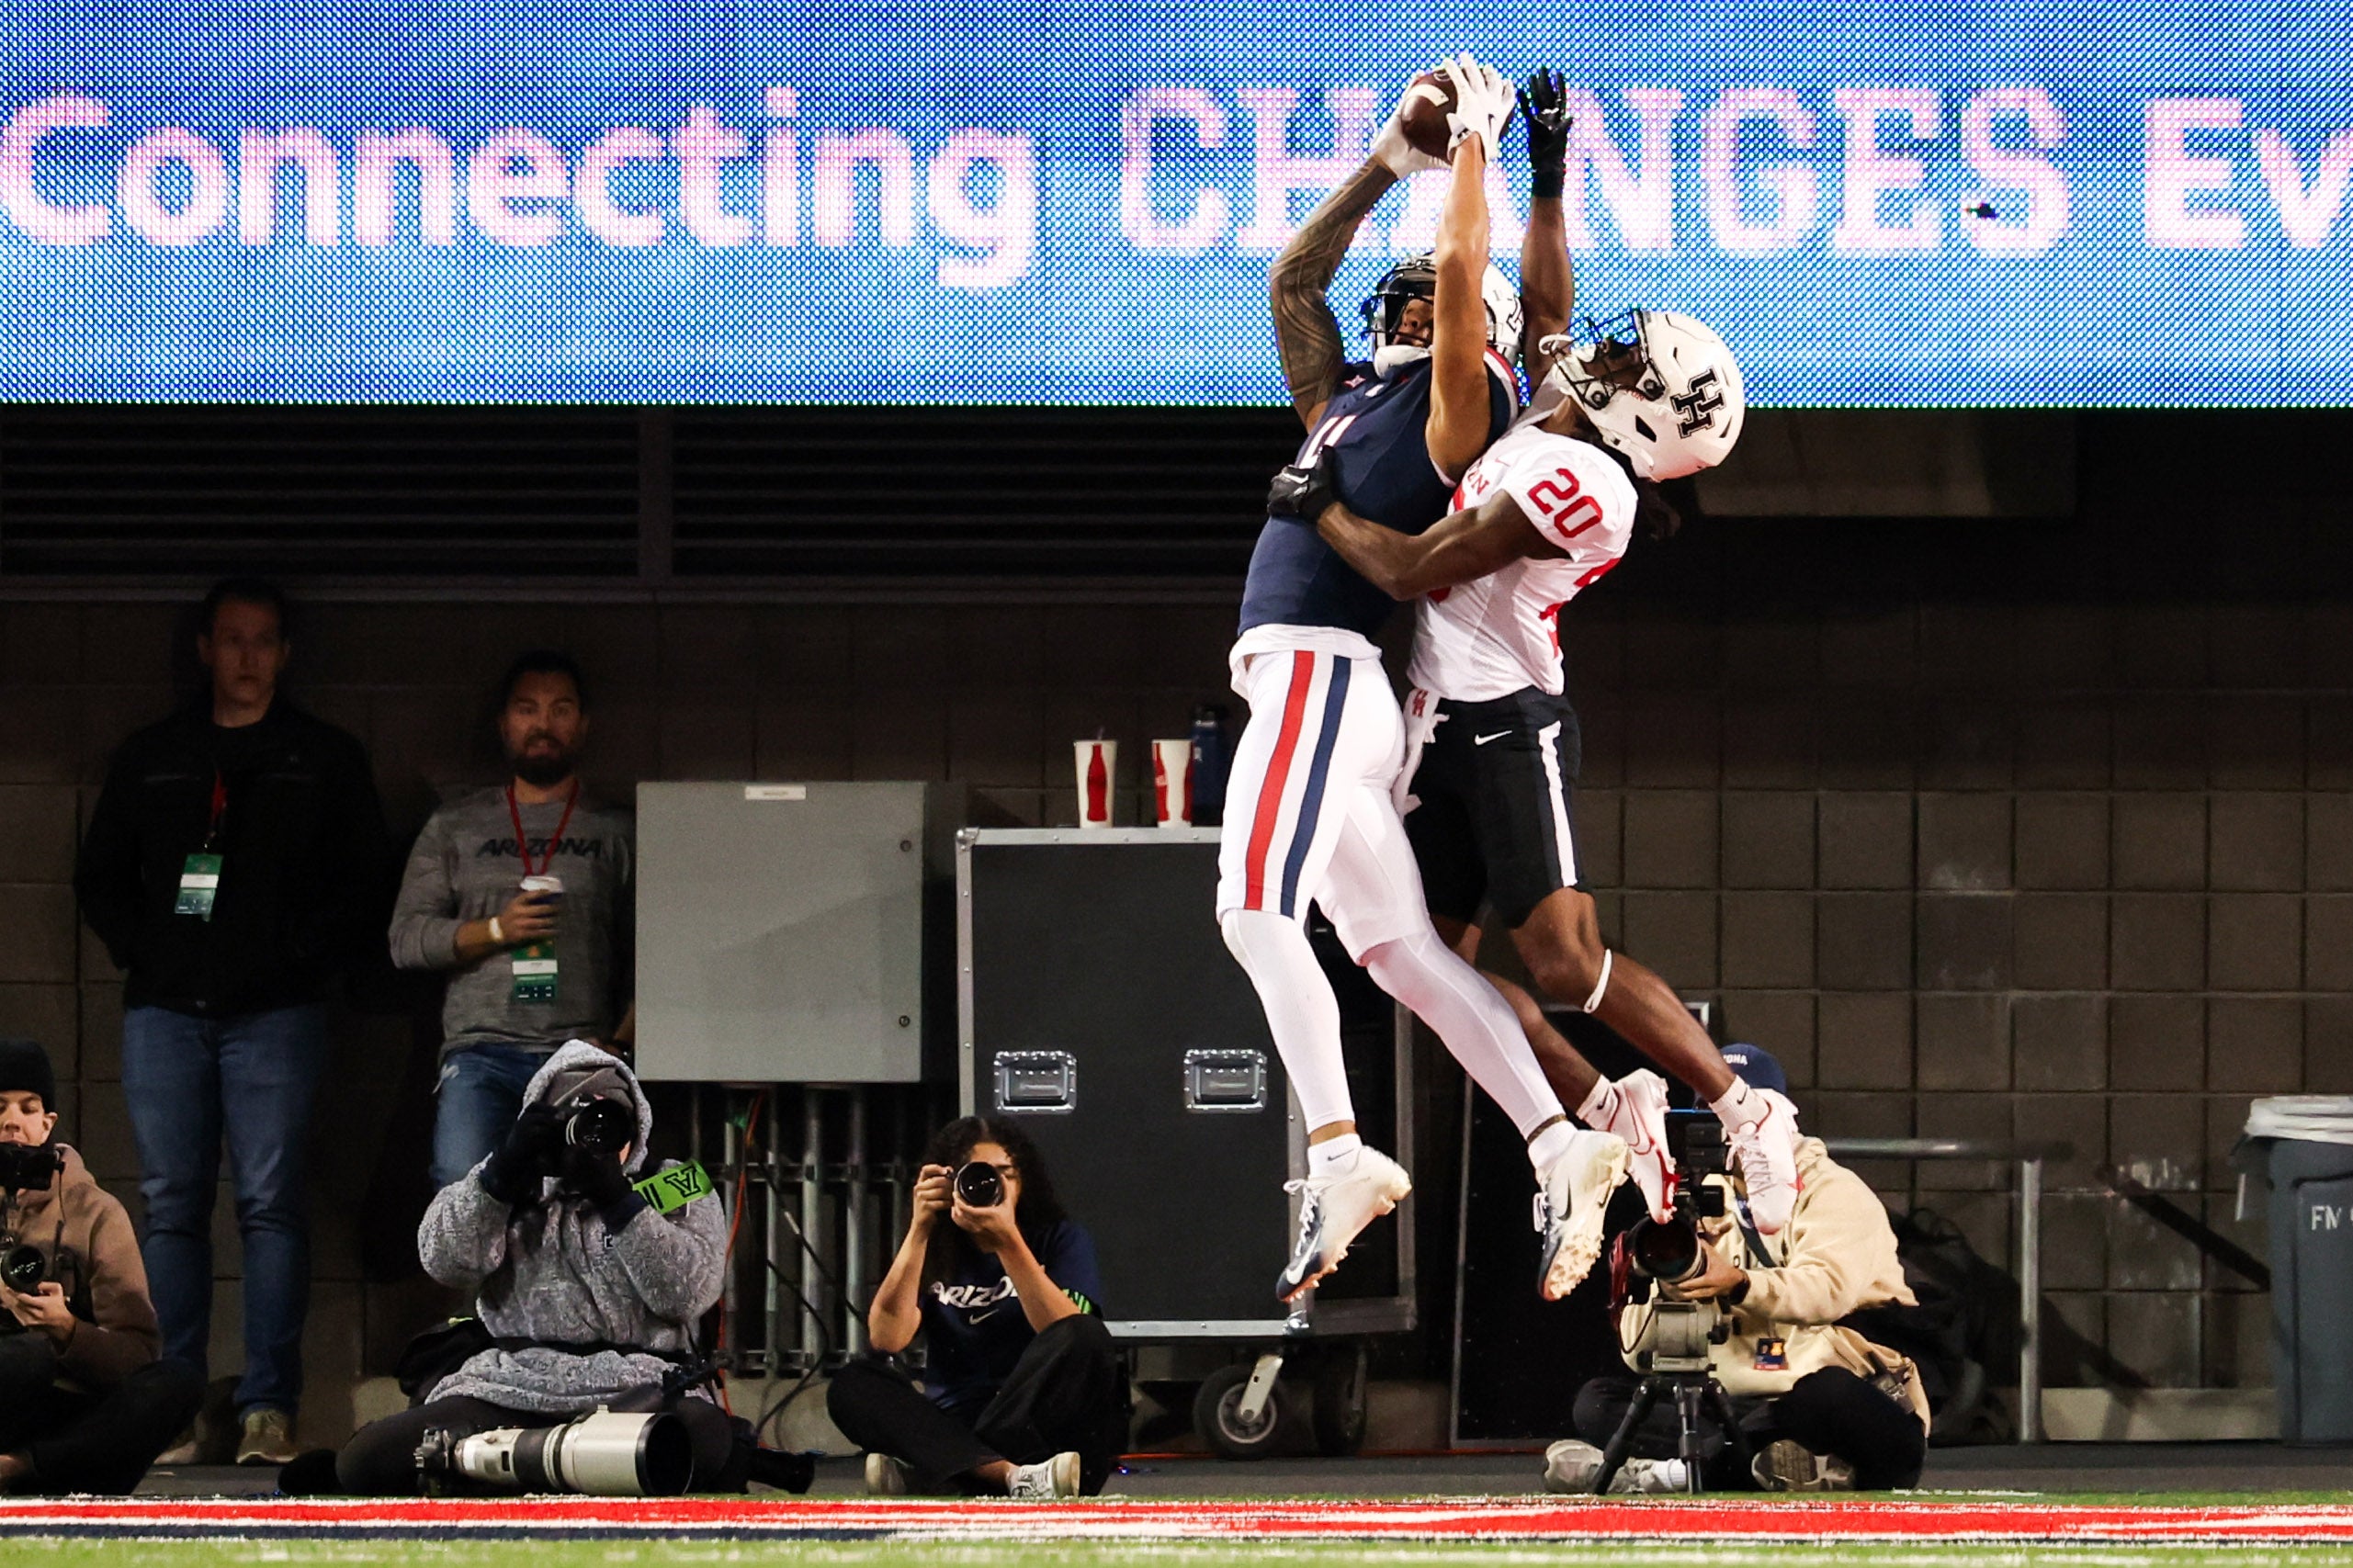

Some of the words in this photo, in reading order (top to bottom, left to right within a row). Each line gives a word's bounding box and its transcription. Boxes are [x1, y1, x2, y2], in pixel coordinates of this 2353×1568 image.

[0, 87, 1035, 287] Connecting
[1527, 468, 1602, 538] 20
[663, 1166, 702, 1198] A
[931, 1275, 1019, 1309] ARIZO
